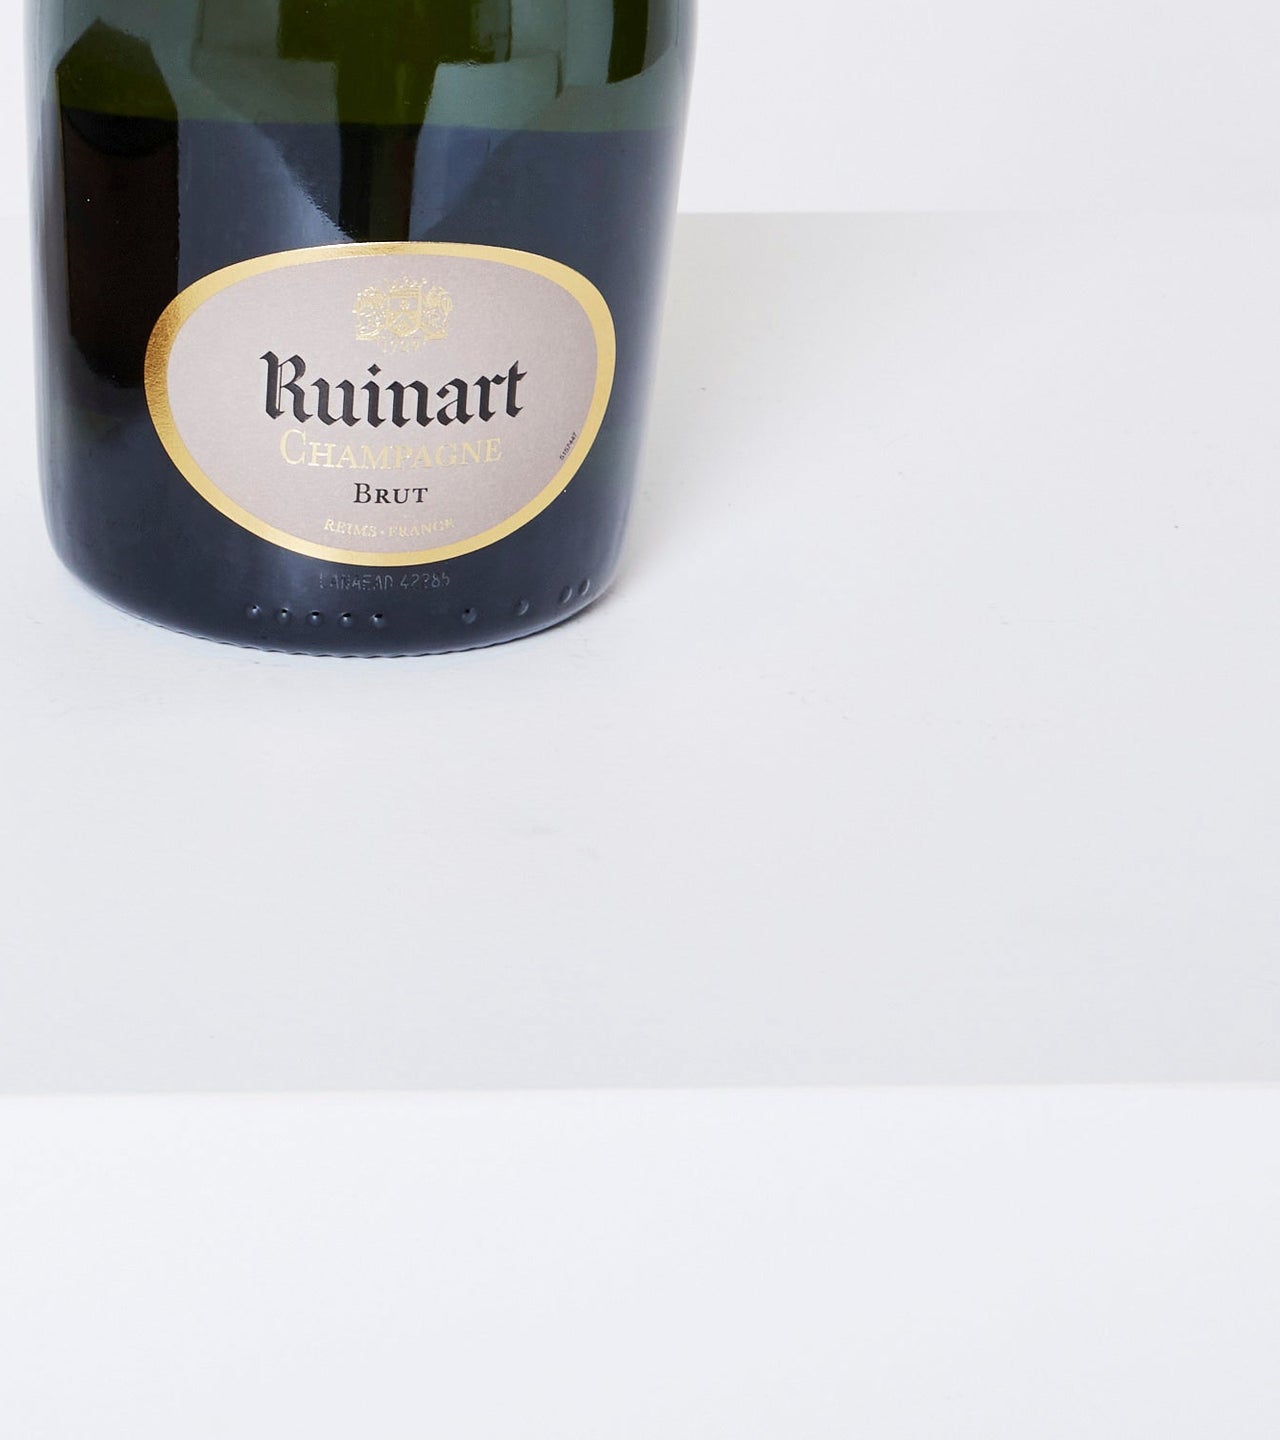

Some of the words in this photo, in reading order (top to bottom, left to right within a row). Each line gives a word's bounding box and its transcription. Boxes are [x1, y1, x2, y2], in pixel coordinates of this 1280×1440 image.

[259, 350, 528, 428] Ruinart
[279, 428, 502, 469] CHAMPAGNE
[353, 482, 429, 504] BRUT
[323, 518, 378, 538] REIMS
[388, 518, 455, 538] FRANCE
